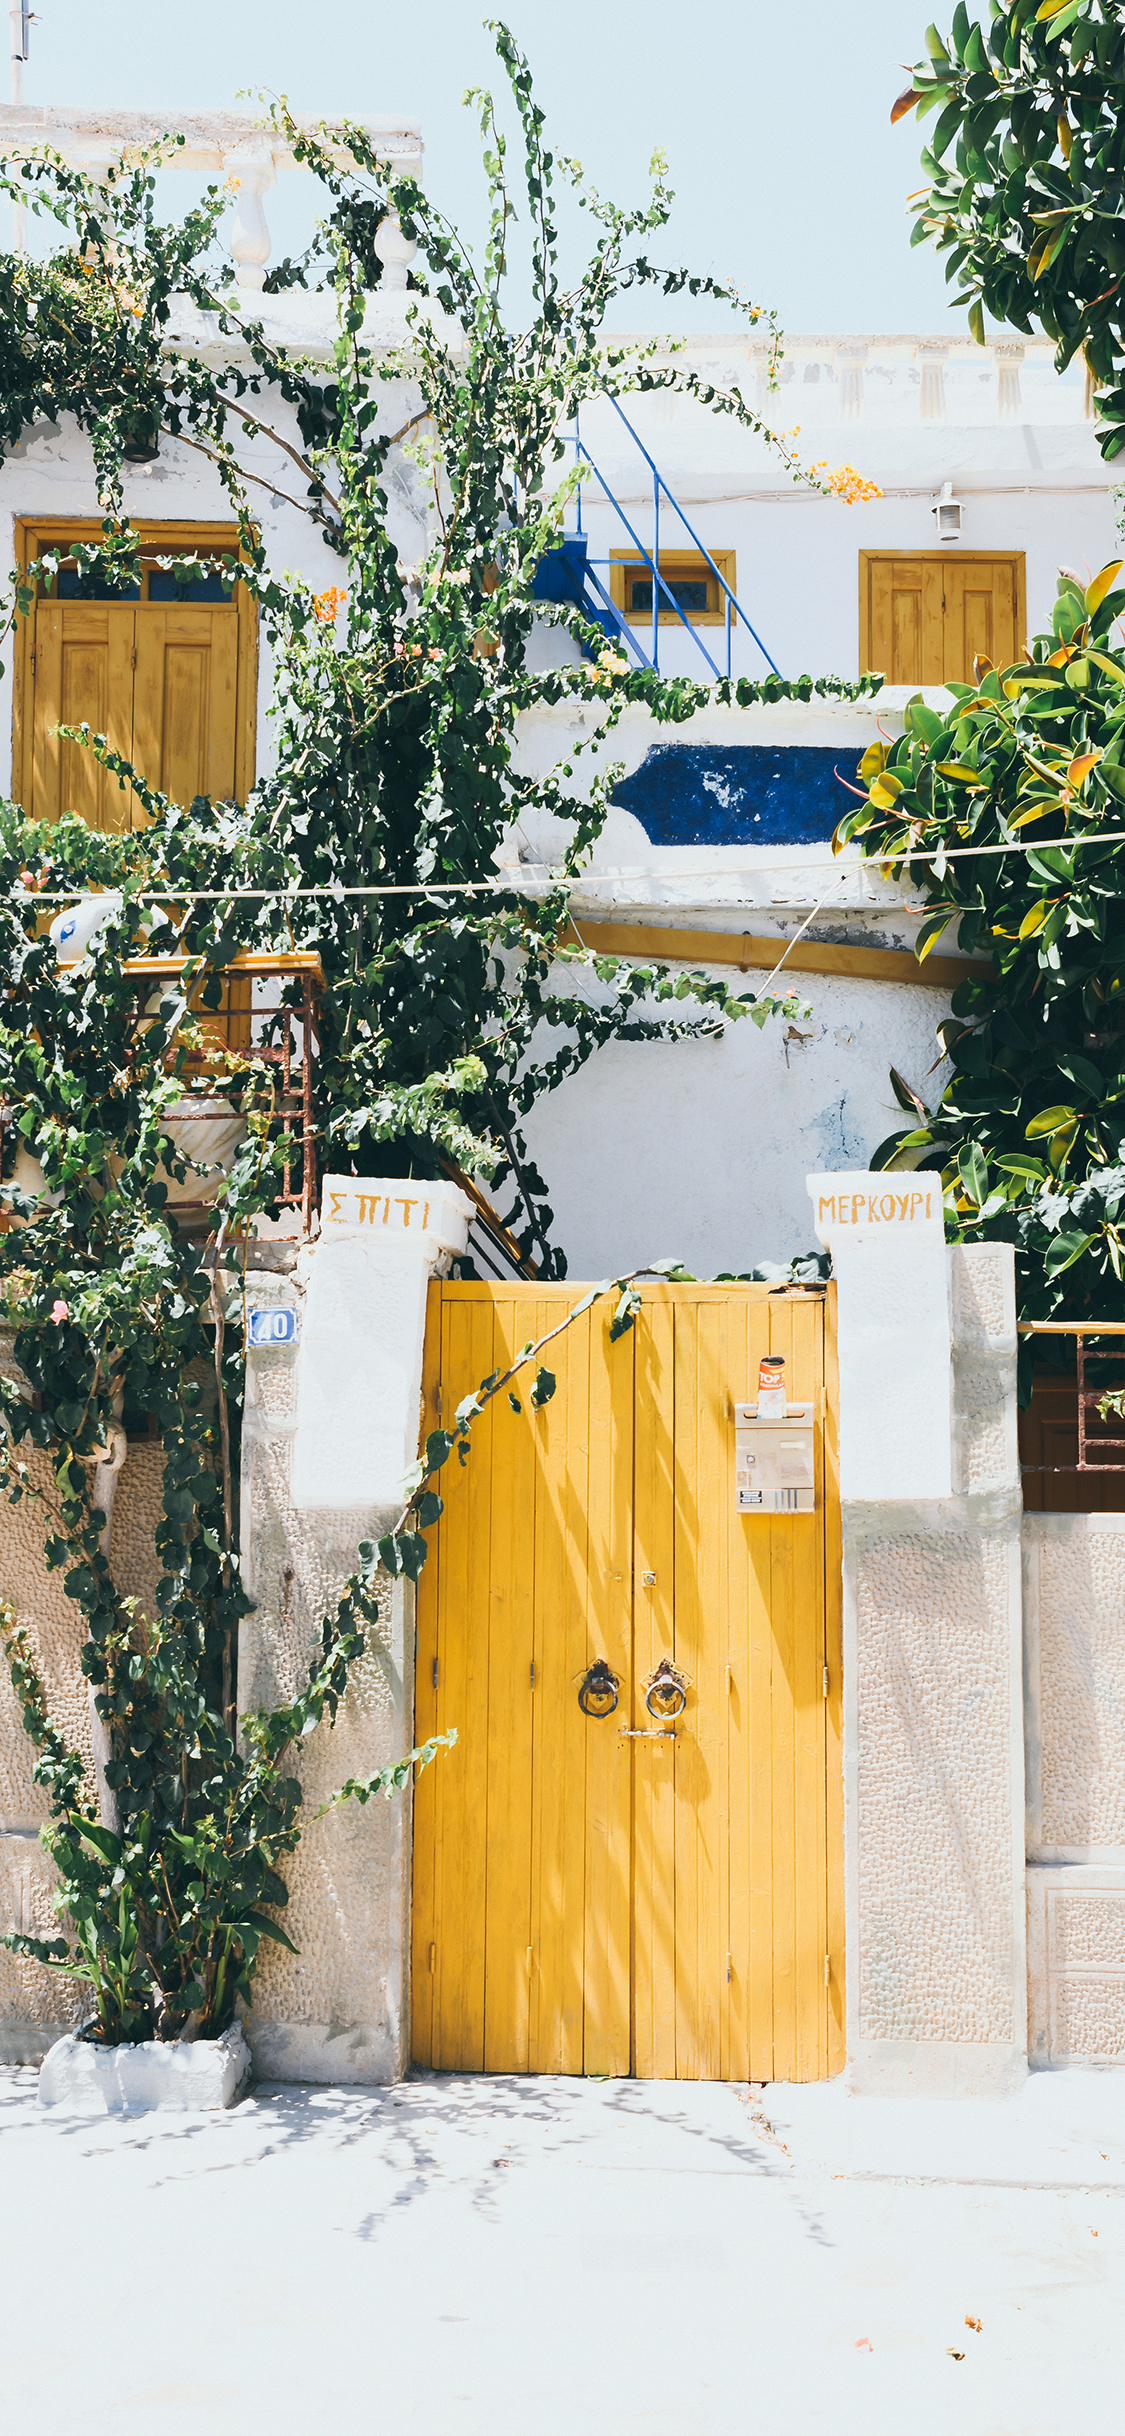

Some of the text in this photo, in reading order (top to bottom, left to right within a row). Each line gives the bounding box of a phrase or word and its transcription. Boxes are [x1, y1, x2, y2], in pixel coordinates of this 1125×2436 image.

[325, 1192, 430, 1230] ΣΠΙΤΙ
[818, 1192, 932, 1225] ΜΕΡΚΟΥΡΙ
[759, 1371, 781, 1384] TOP
